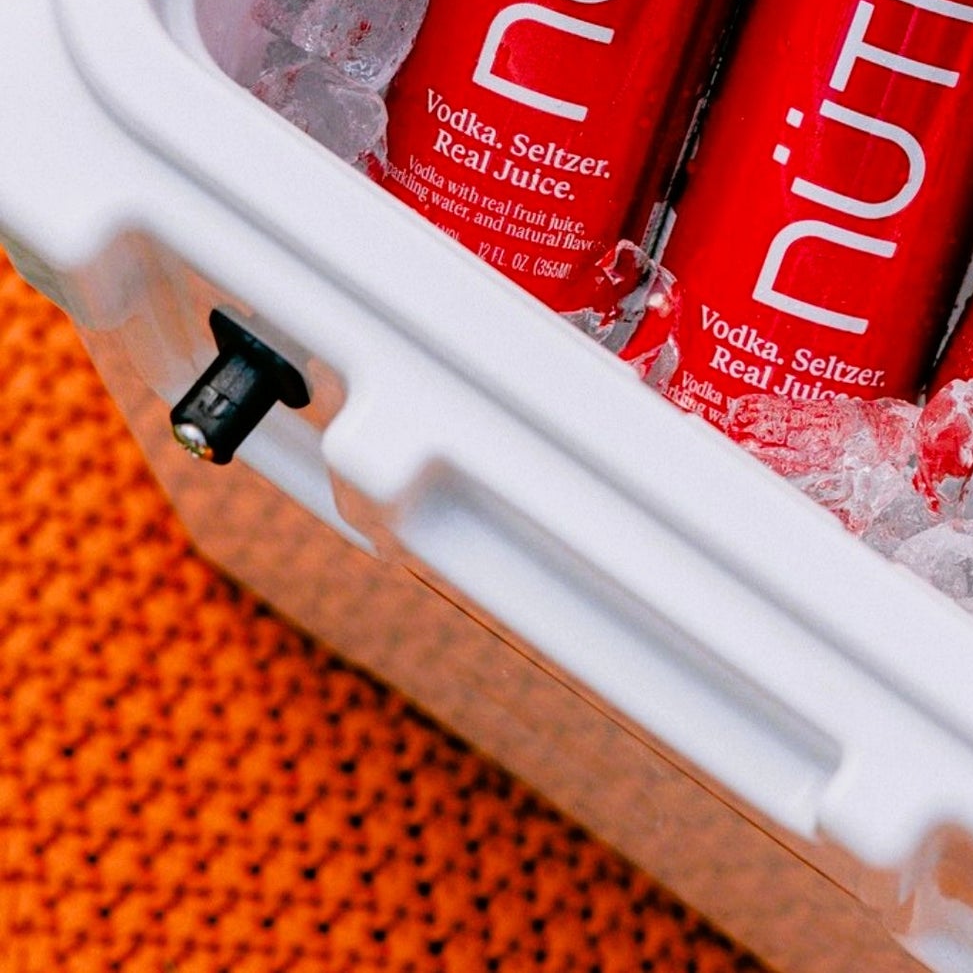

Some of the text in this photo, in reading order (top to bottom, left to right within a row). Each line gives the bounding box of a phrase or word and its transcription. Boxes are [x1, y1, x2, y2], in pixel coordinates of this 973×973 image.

[426, 88, 610, 179] Vodka. Seltzer.
[432, 129, 576, 201] Real Juice.
[410, 154, 585, 236] Vodka with real fruit juice,
[431, 191, 471, 222] water,
[474, 211, 506, 232] and
[505, 222, 562, 248] natural
[491, 246, 507, 267] FL.
[511, 252, 530, 272] OZ.
[701, 304, 885, 387] Vodka. Seltzer.
[709, 345, 772, 390] Real
[682, 370, 723, 406] Vodka
